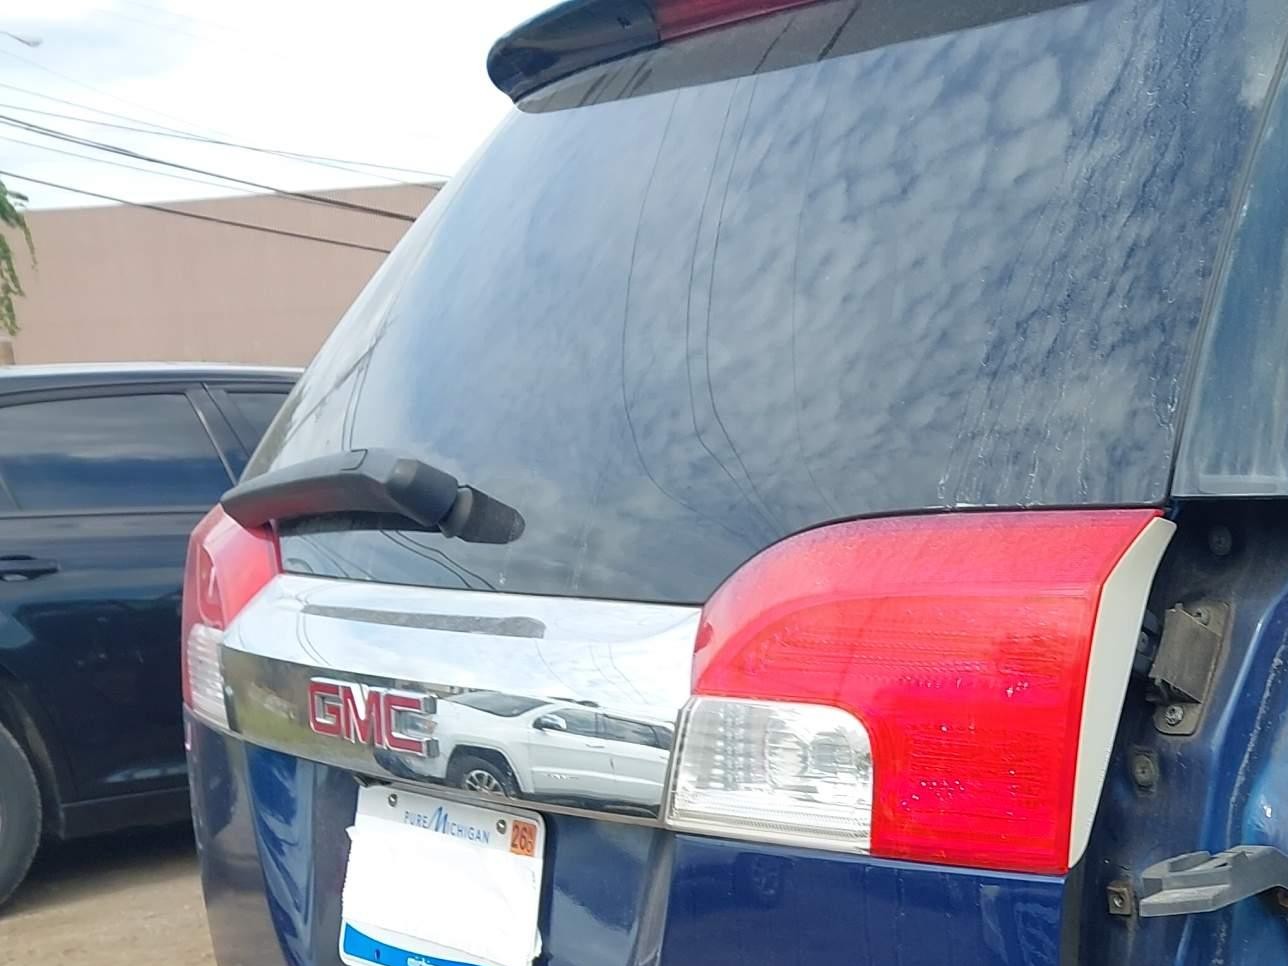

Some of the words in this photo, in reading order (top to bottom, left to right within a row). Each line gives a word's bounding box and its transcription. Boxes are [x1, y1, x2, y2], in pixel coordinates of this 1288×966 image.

[309, 677, 437, 757] GMC
[404, 811, 429, 829] PURE
[429, 806, 490, 844] MICHIGAN
